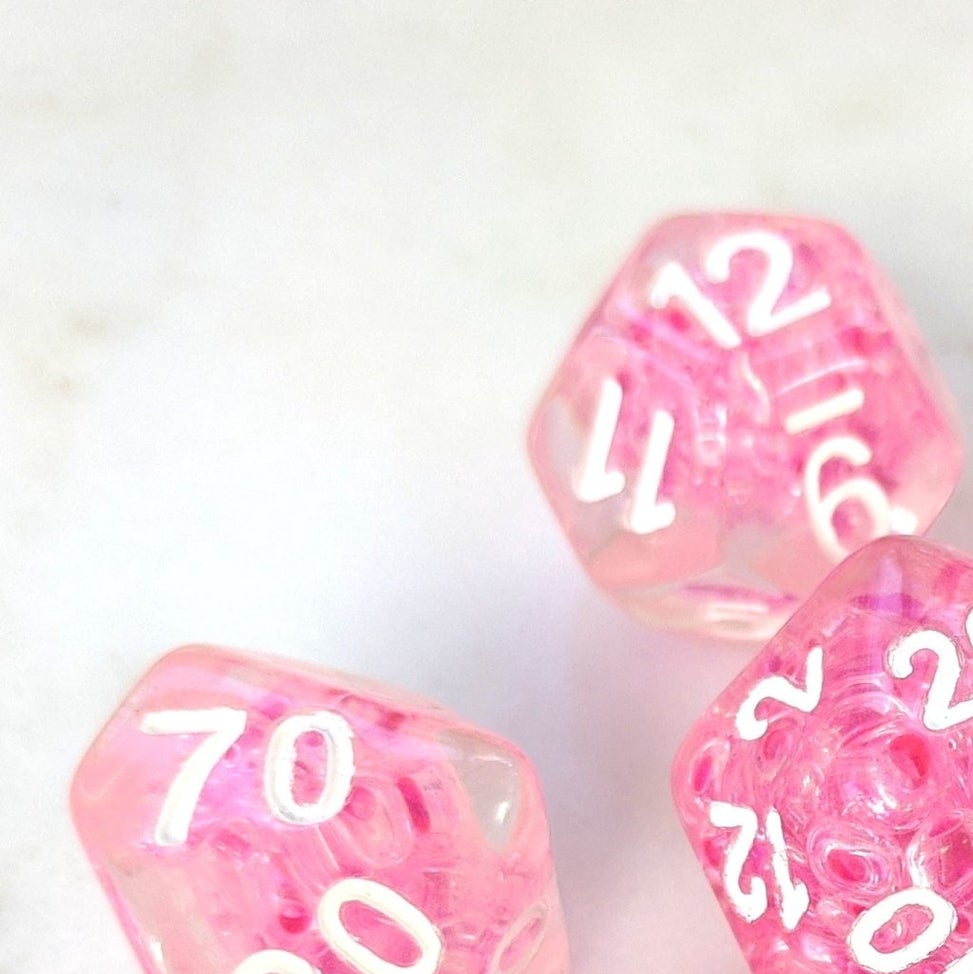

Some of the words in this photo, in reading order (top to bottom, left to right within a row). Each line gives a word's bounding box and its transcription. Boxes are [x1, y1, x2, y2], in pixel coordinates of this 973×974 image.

[651, 230, 832, 349] 12
[571, 377, 677, 535] 11
[735, 646, 823, 741] 2
[140, 706, 356, 846] 70
[709, 799, 811, 931] 12
